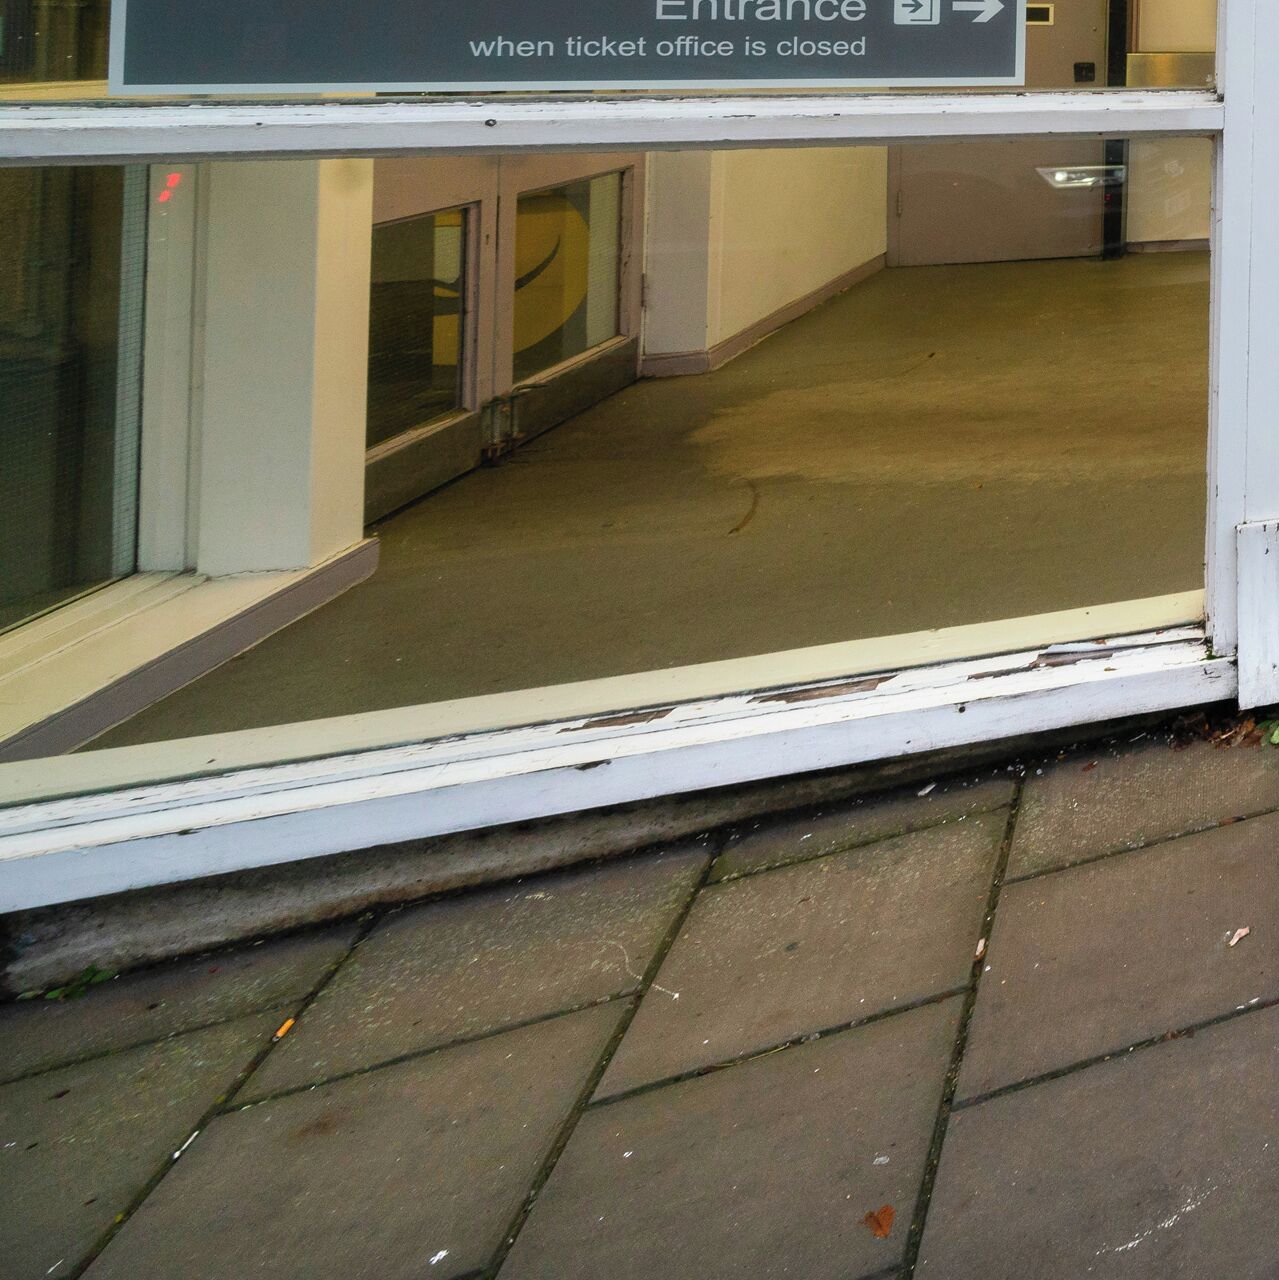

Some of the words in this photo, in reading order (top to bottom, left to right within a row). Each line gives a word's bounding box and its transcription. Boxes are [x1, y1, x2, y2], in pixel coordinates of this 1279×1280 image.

[469, 36, 554, 57] when
[565, 36, 647, 57] ticket
[656, 35, 734, 56] office
[745, 36, 766, 56] is
[776, 36, 866, 56] closed
